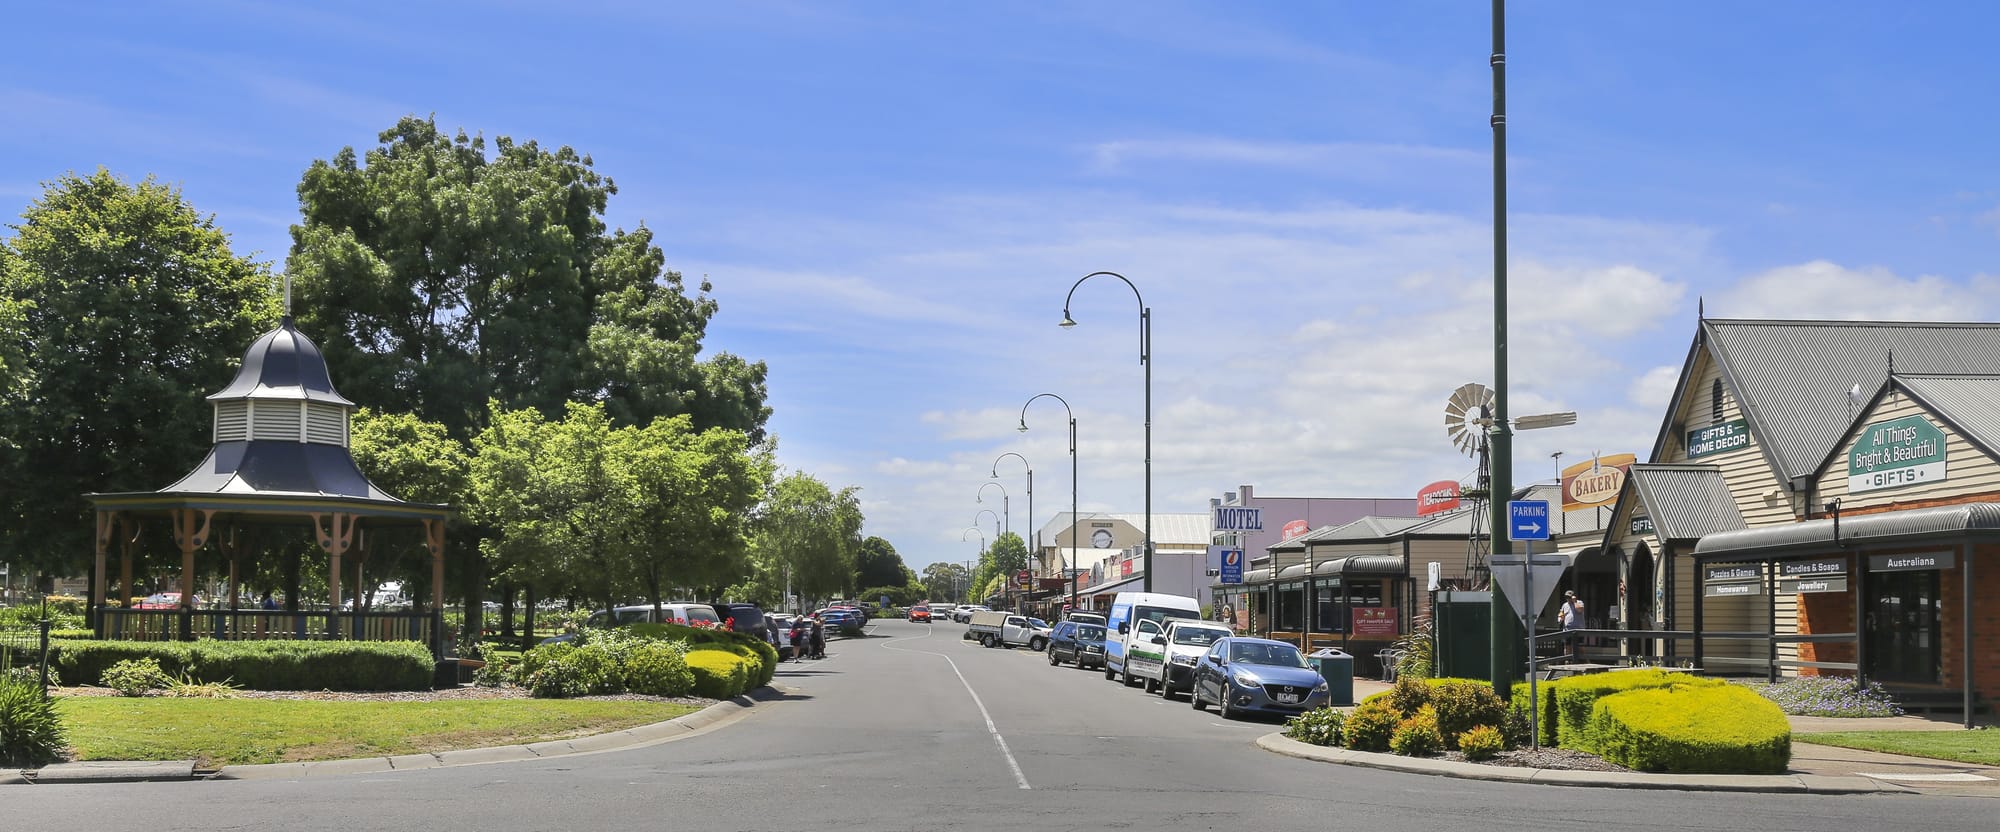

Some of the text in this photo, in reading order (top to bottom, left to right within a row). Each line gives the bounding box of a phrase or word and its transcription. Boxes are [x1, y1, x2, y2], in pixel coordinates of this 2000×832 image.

[1701, 424, 1734, 441] GIFTS &
[1872, 425, 1917, 446] All Things
[1689, 433, 1746, 455] HOME DECOR
[1855, 437, 1937, 472] Bright & Beautiful
[1575, 471, 1620, 497] BAKERY
[1873, 468, 1916, 487] GIFTS
[1422, 487, 1454, 507] TEAROOMS
[1216, 508, 1263, 530] MOTEL
[1512, 505, 1546, 518] PARKING
[1786, 562, 1840, 574] Candles & Soaps
[1887, 556, 1935, 568] Australiana
[1710, 570, 1730, 579] Puzzles
[1735, 568, 1756, 577] Games
[1716, 585, 1749, 593] Homewares
[1797, 580, 1828, 591] Jewellery
